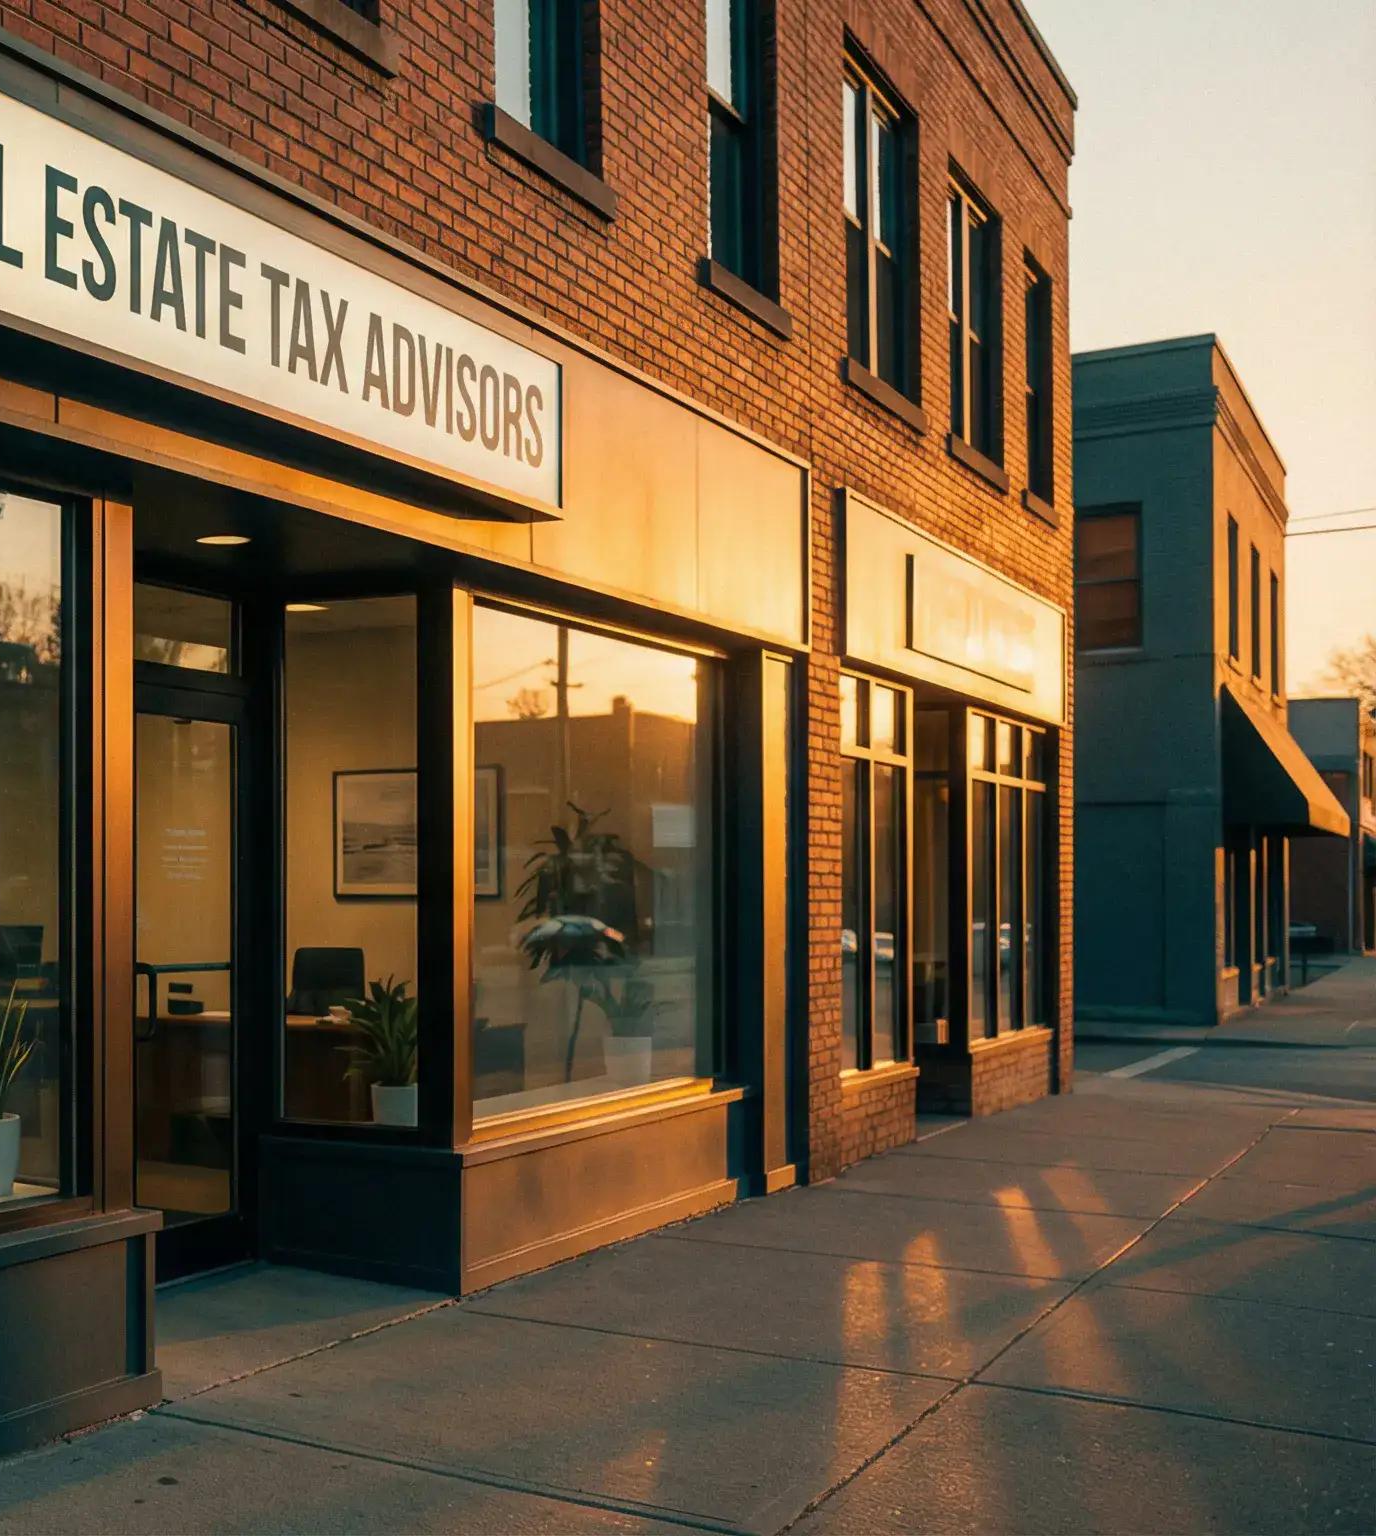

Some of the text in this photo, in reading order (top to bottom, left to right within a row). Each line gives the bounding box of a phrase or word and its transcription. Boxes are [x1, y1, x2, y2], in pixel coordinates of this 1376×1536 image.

[44, 164, 247, 355] ESTATE
[260, 262, 350, 394] TAX
[362, 312, 544, 469] ADVISORS
